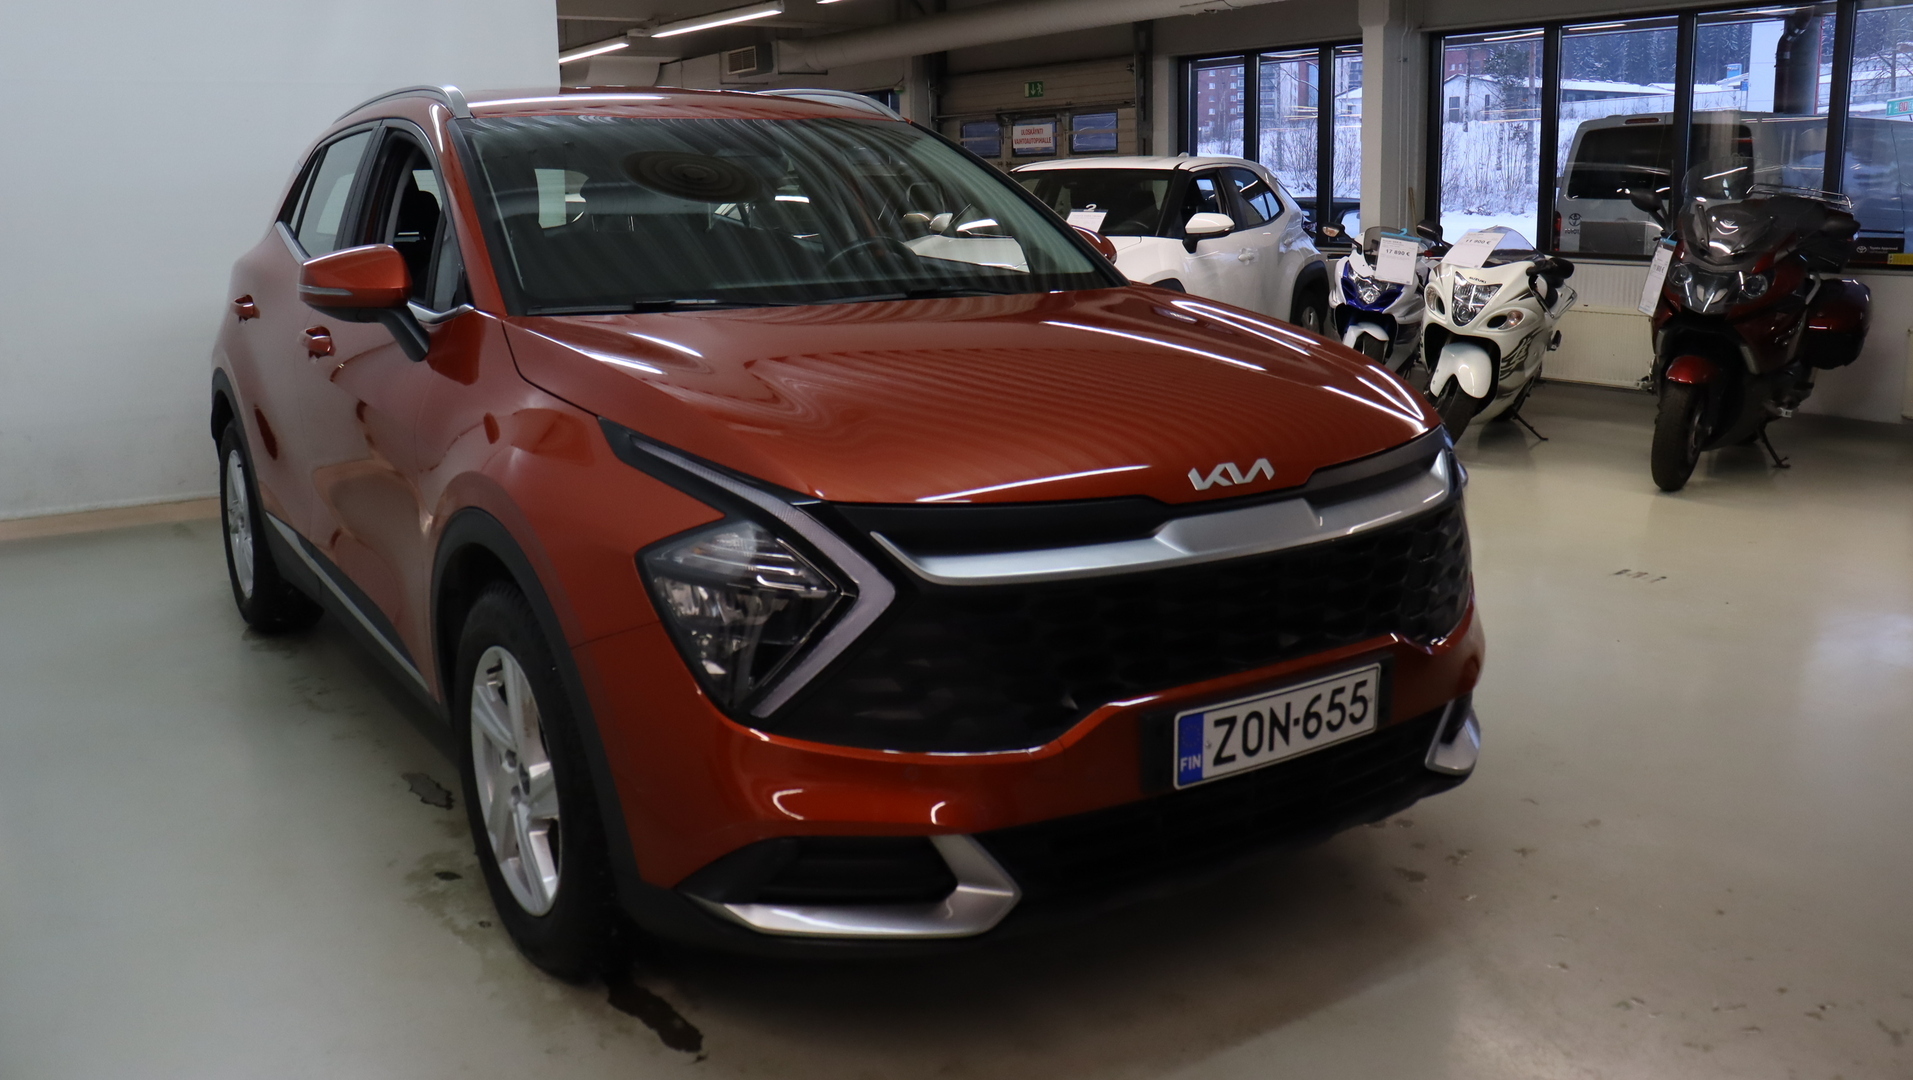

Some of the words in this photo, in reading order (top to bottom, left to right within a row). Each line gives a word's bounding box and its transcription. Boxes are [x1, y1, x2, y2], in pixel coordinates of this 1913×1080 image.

[1469, 276, 1487, 284] SUZUKI
[1187, 458, 1275, 491] KIA
[1212, 679, 1368, 767] ZON-655
[1180, 754, 1201, 772] FIN
